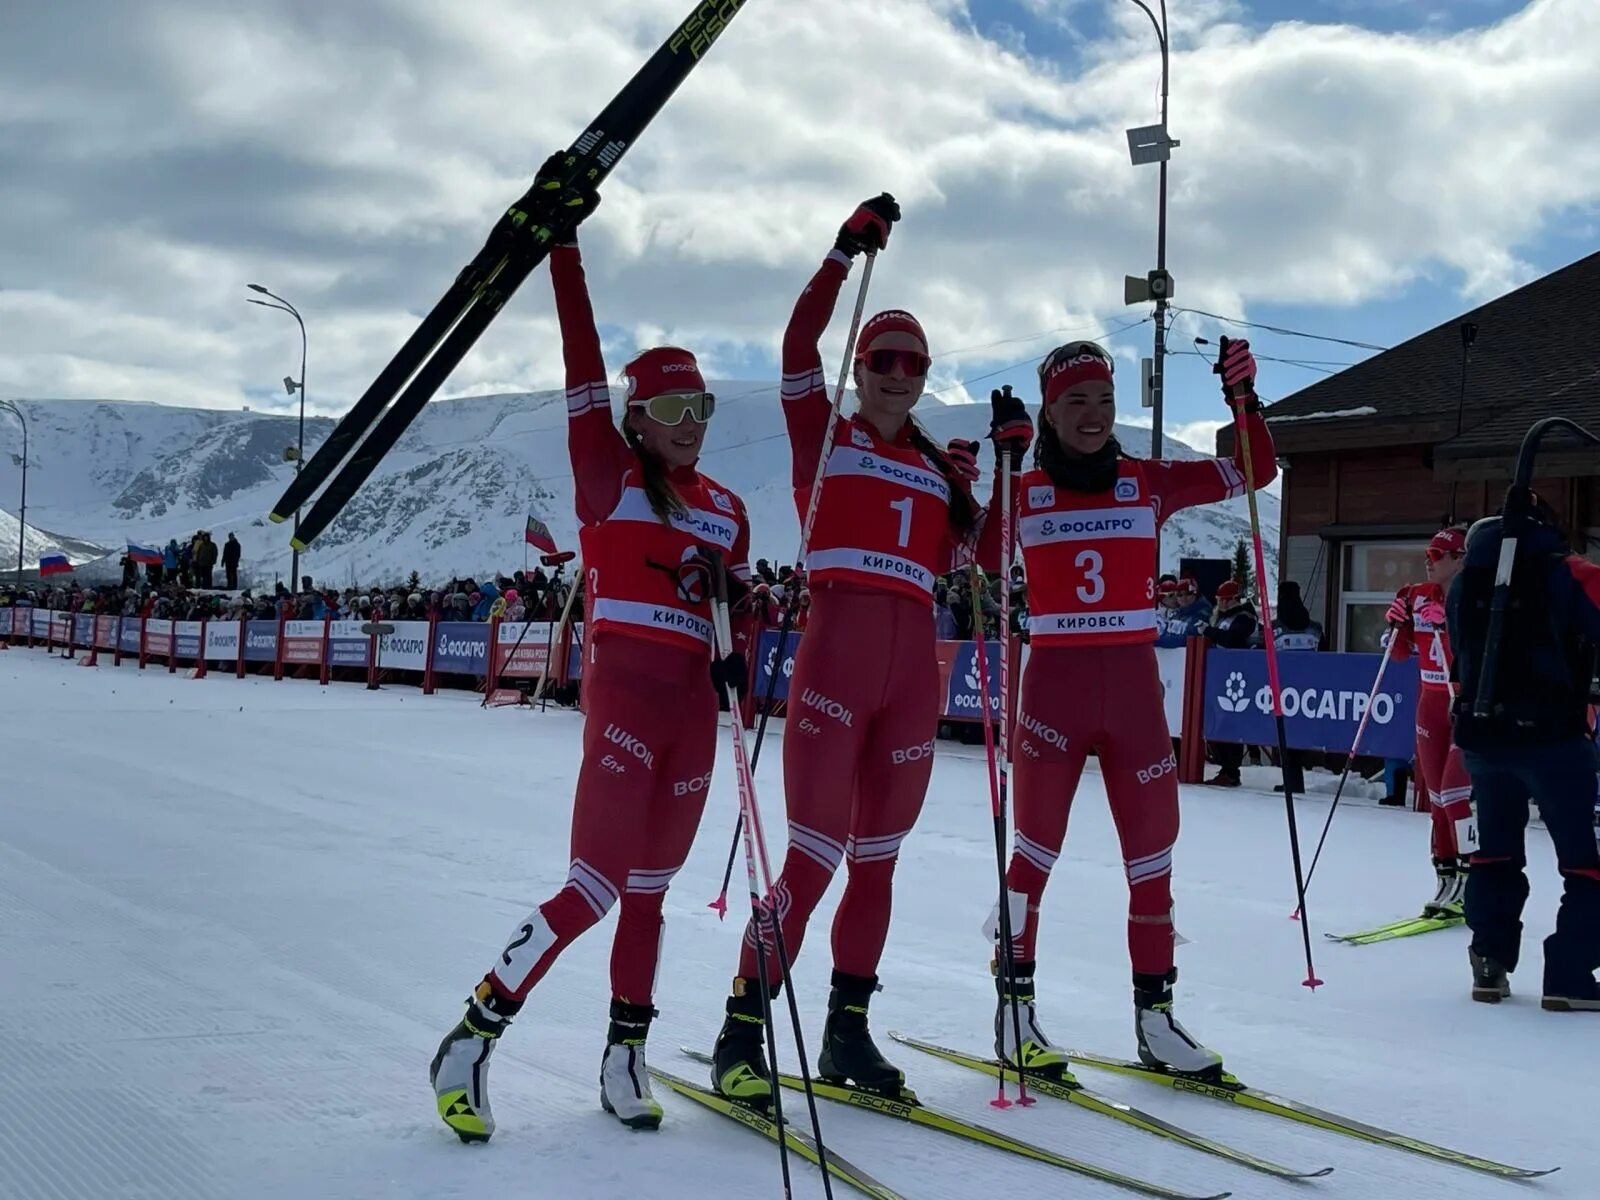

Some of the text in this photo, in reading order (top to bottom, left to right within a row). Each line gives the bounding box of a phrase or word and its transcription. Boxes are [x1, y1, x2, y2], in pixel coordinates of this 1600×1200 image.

[879, 464, 948, 496] ФОСАГРО
[889, 496, 913, 548] 1
[1058, 518, 1132, 534] ФОСАГРО
[862, 554, 925, 583] КИРОВСК
[1074, 550, 1105, 604] 3
[1145, 576, 1154, 600] 3
[1057, 614, 1126, 629] КИРОВСК
[448, 640, 485, 658] ФОСАГРО
[800, 687, 853, 728] LUKOIL
[1019, 711, 1068, 752] LUKOIL
[603, 723, 656, 770] LUKOIL
[1467, 824, 1476, 845] 4
[502, 923, 534, 966] 2
[1172, 1078, 1237, 1101] FISCHER
[847, 1091, 913, 1117] FISCHER
[728, 1106, 772, 1134] FISCHER
